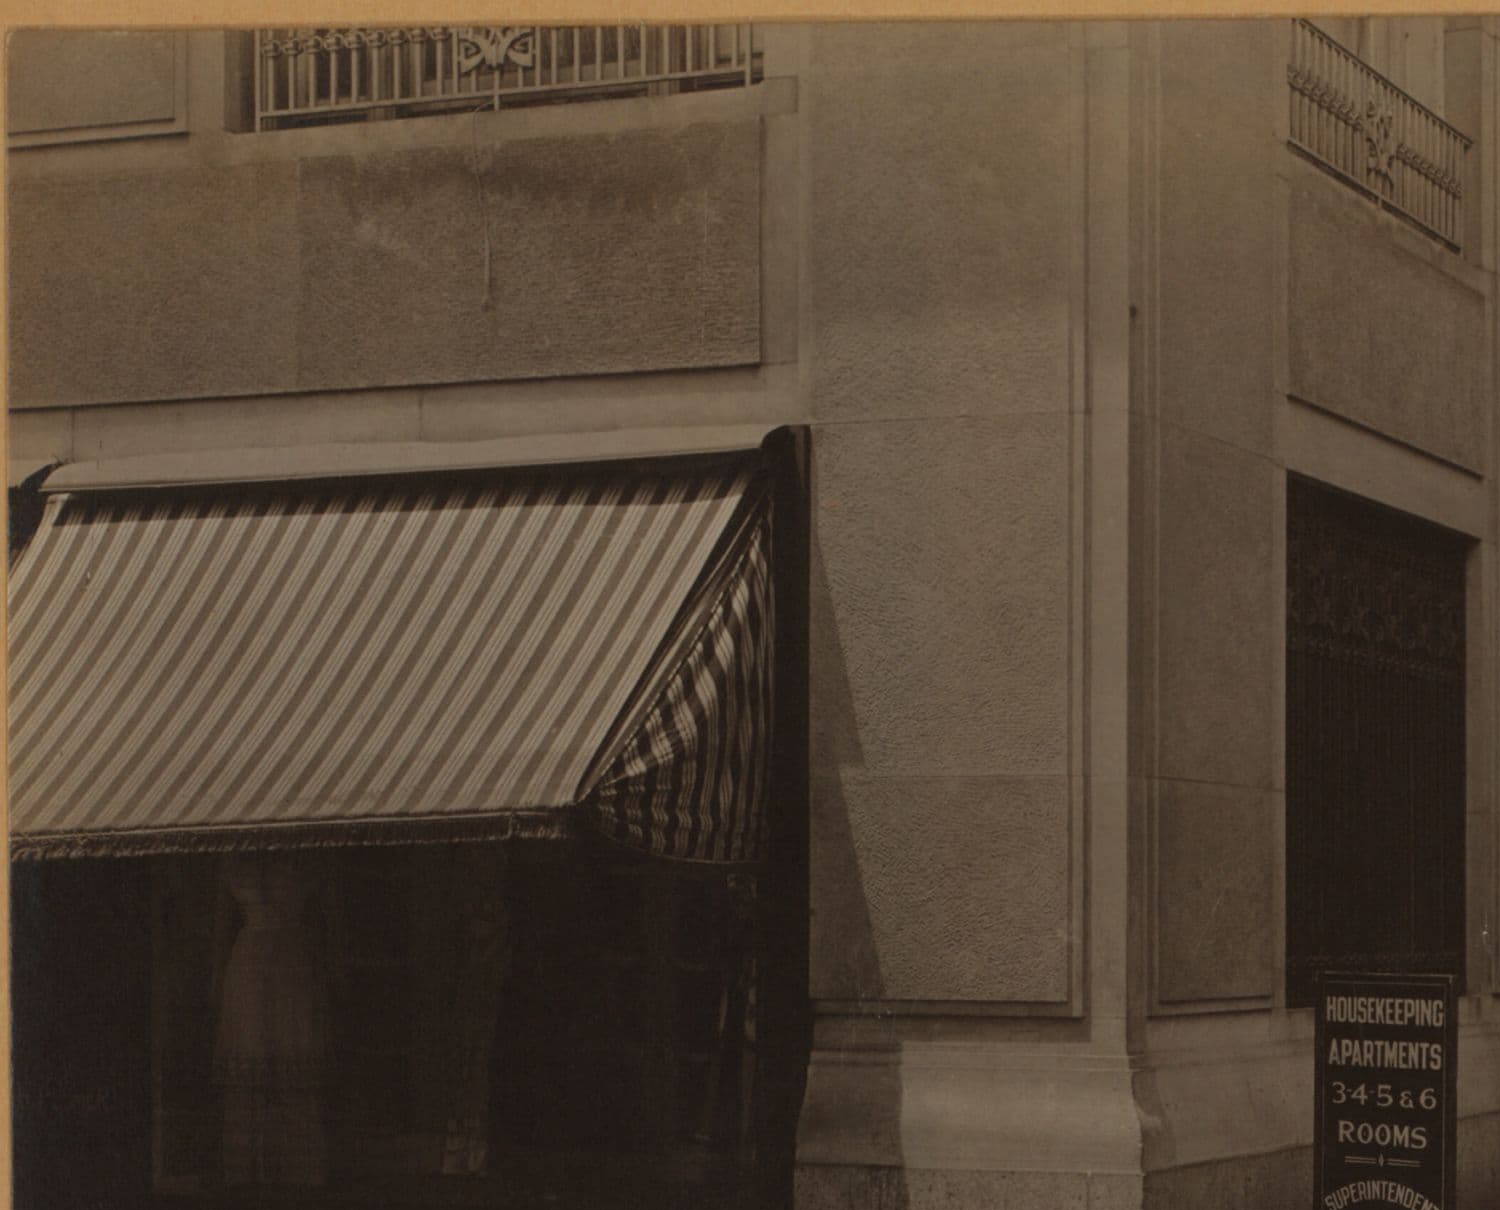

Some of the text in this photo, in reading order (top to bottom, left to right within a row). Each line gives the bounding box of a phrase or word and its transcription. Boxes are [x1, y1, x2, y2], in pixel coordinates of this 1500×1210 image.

[1326, 996, 1444, 1027] HOUSEKEEPING
[1328, 1038, 1442, 1071] APARTMENTS
[1338, 1120, 1427, 1149] ROOMS
